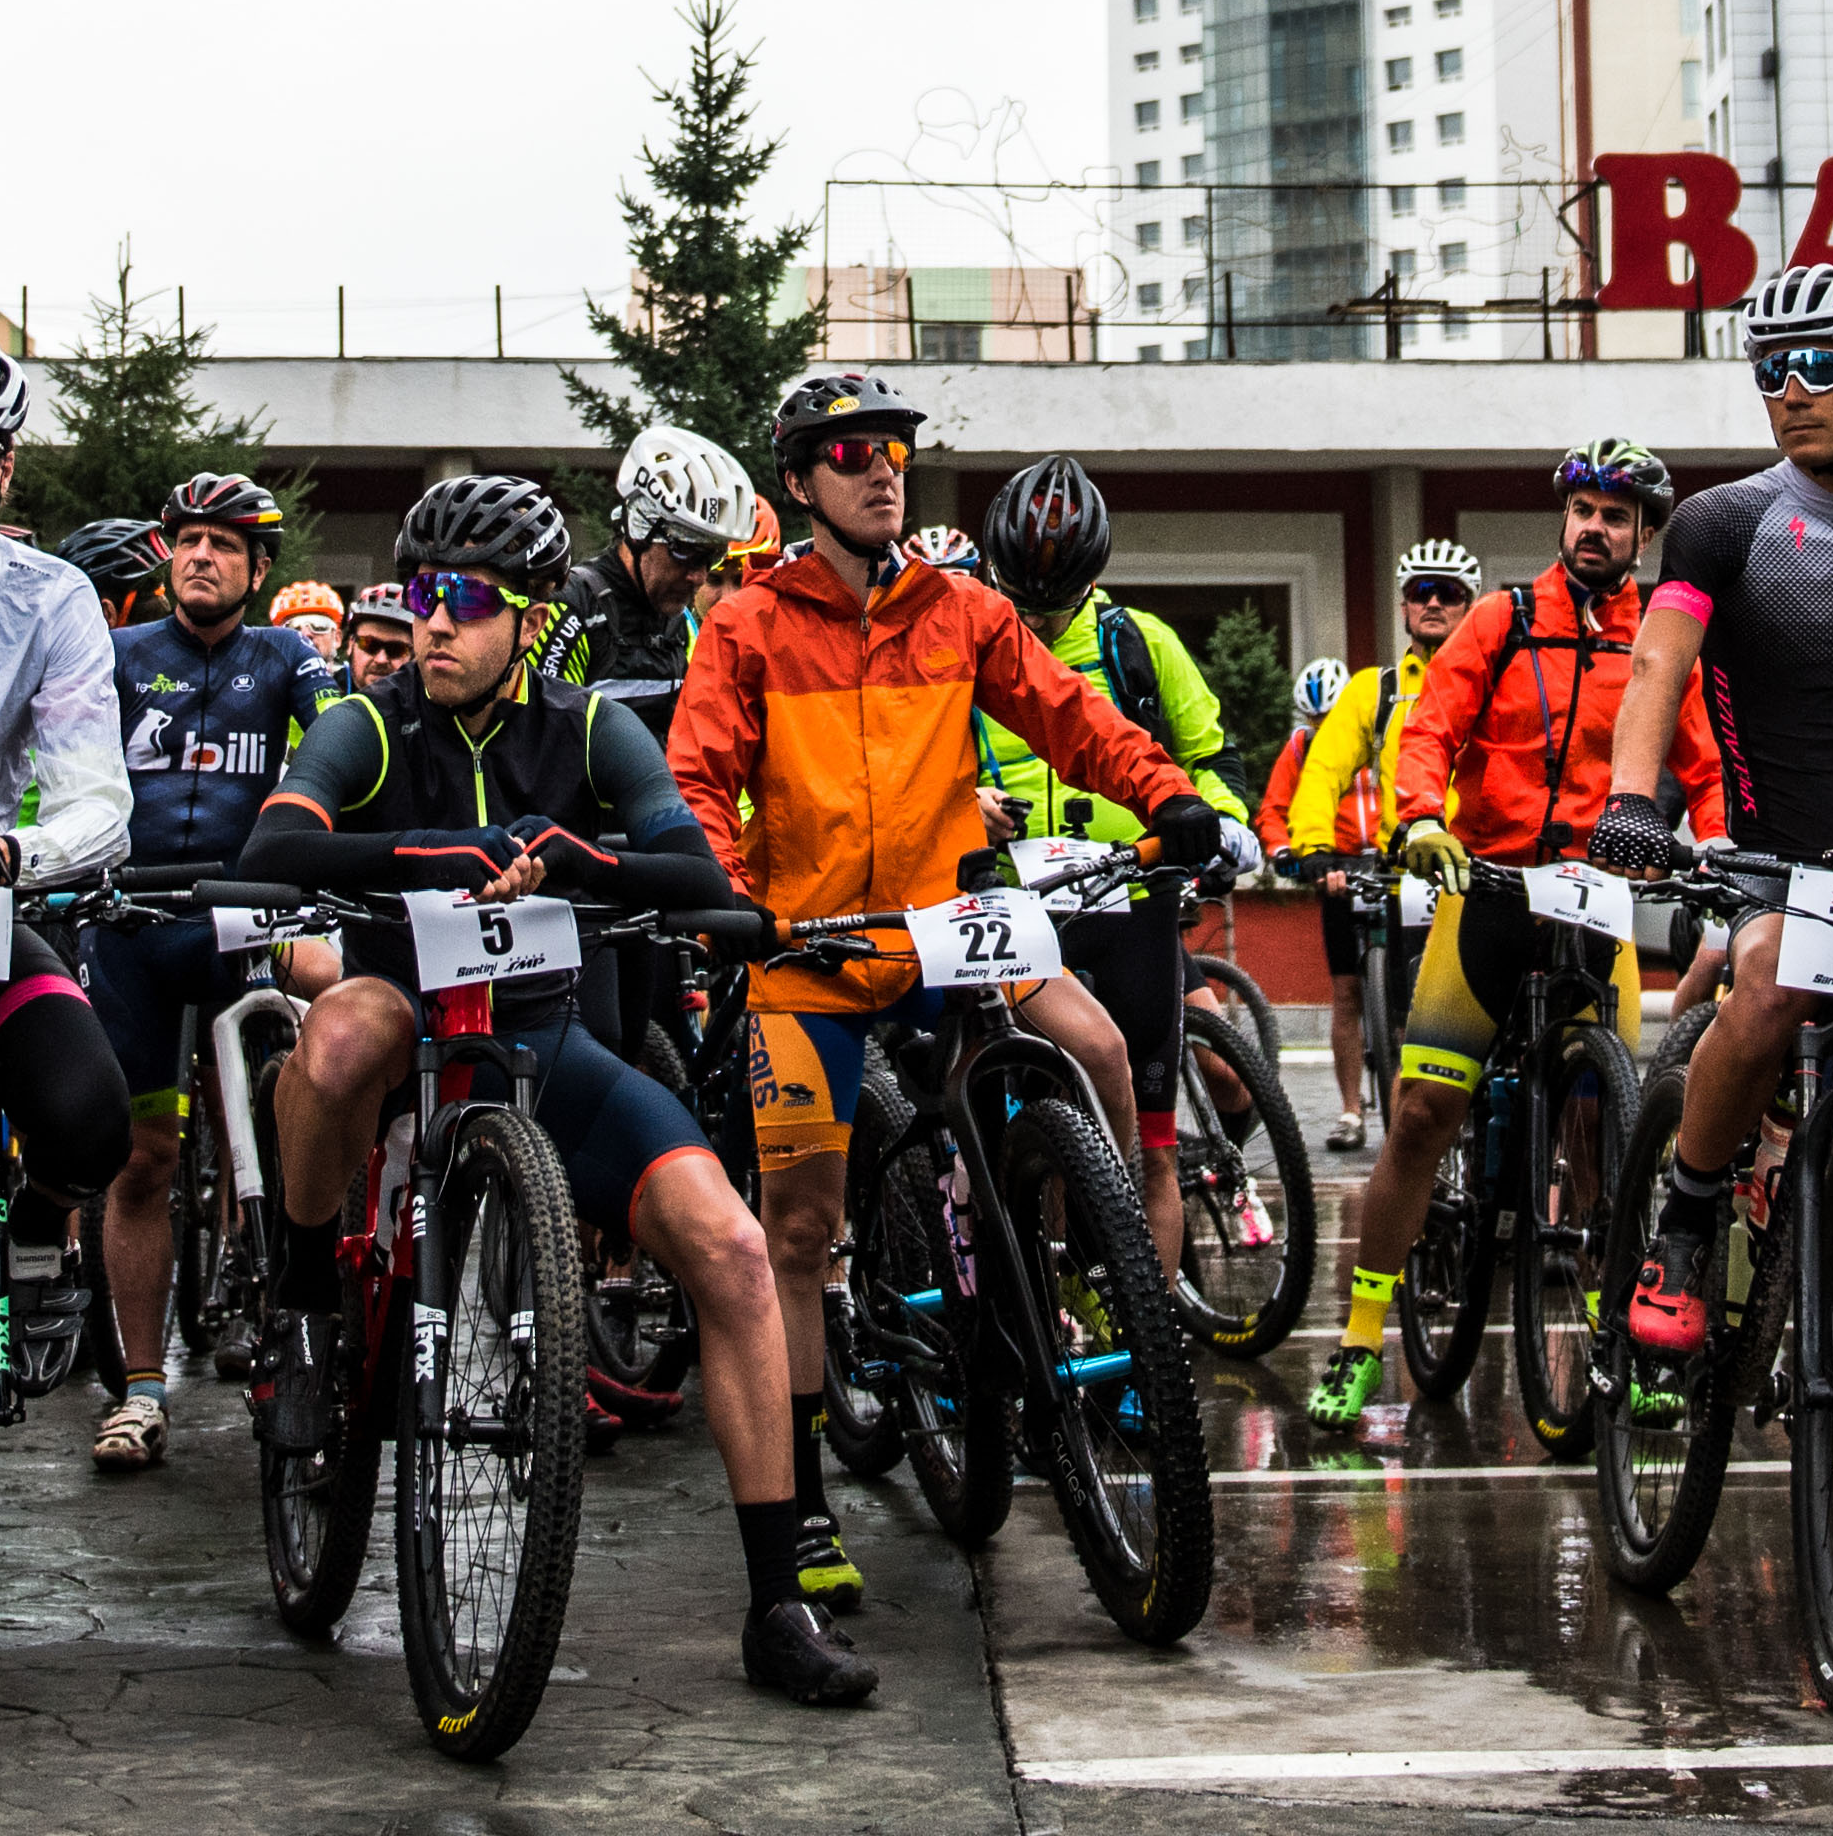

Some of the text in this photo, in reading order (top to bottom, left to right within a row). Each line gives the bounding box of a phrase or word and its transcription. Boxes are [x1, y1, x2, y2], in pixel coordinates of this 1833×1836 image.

[181, 731, 267, 775] billi
[1572, 883, 1589, 911] 7
[477, 906, 515, 956] 5
[958, 920, 1017, 963] 22
[456, 961, 499, 978] Santini
[954, 967, 990, 980] Santini
[15, 1252, 57, 1263] SHIMANO
[415, 1323, 435, 1383] FOX
[1050, 1430, 1088, 1508] cycles
